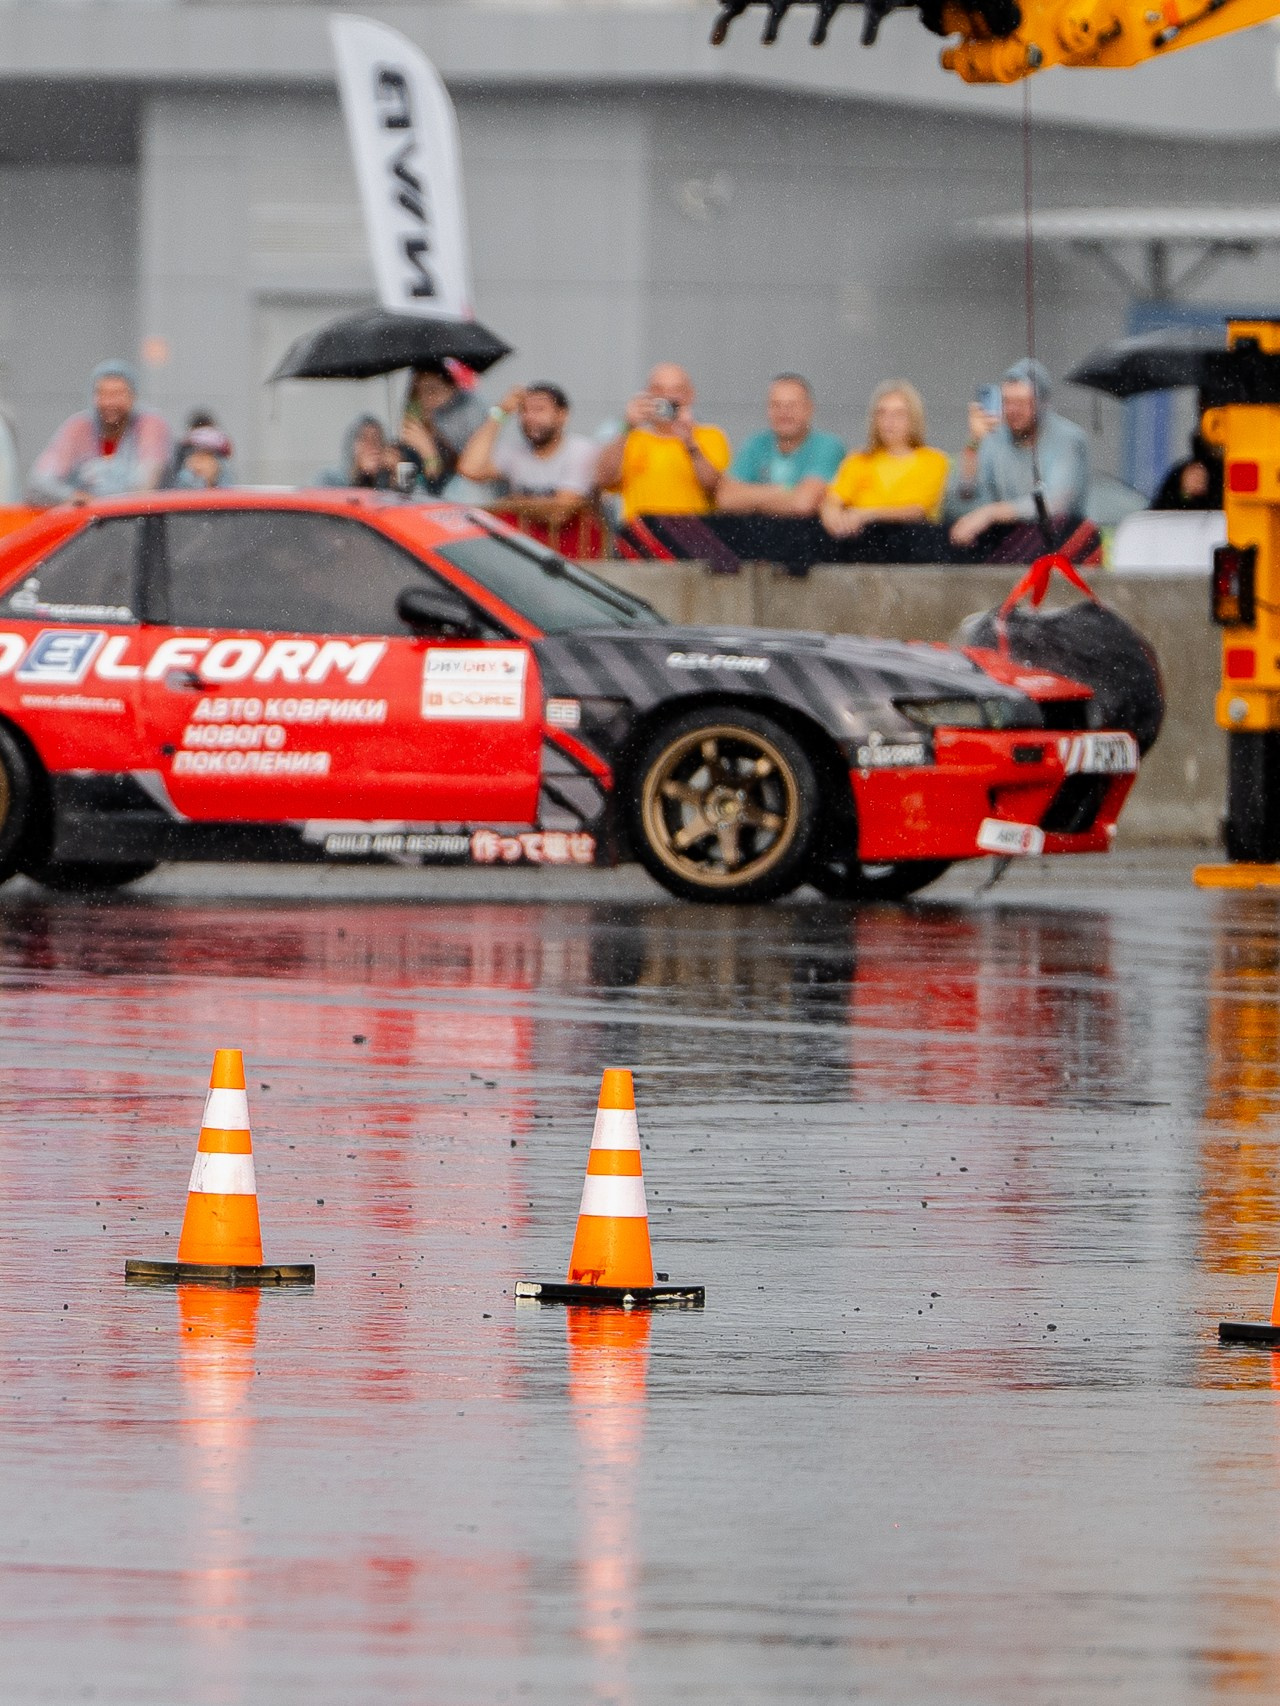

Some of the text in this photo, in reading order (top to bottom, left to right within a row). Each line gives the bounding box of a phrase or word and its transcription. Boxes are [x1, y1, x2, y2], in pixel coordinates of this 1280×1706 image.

[193, 698, 386, 723] АВТО КОВРИКИ
[183, 725, 286, 748] НОВОГО
[172, 751, 331, 775] ПОКОЛЕНИЯ
